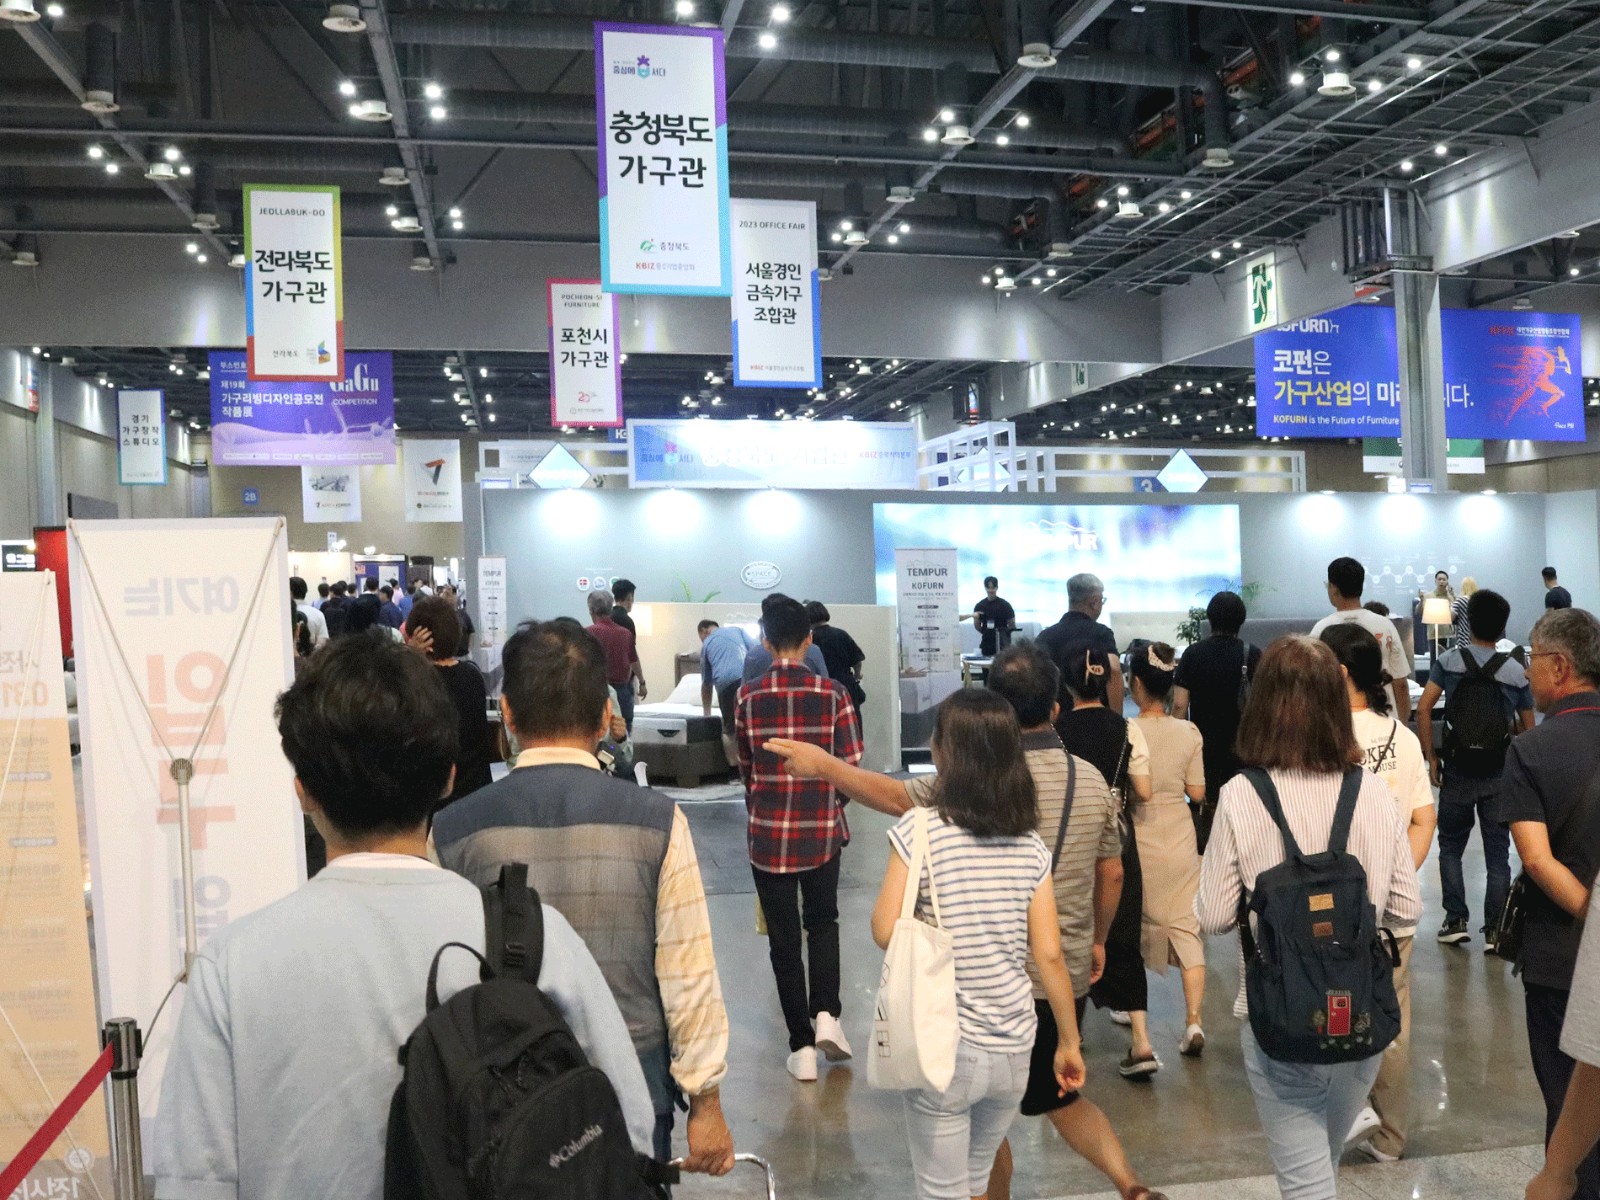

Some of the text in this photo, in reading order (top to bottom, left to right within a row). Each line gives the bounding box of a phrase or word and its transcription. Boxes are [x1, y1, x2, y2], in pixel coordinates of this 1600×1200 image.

[609, 110, 713, 146] 충청북도
[618, 155, 707, 188] 가구관
[259, 207, 326, 216] JEOLLABUK-DO
[739, 220, 805, 230] 2023 OFFICE FAIR
[660, 242, 690, 251] 충청북도
[255, 250, 332, 273] 전라북도
[636, 262, 655, 270] KBIZ
[746, 262, 801, 280] 서울경인
[262, 281, 327, 304] 가구관
[746, 284, 802, 302] 금속가구
[754, 307, 797, 324] 조합관
[1277, 319, 1329, 333] FURN
[561, 327, 607, 345] 포천시
[561, 351, 609, 368] 가구관
[1273, 349, 1332, 375] 코펀은
[221, 392, 324, 406] 가구리빙디자인공모전
[1274, 379, 1371, 406] 가구산업의
[332, 397, 378, 406] COMPETITION
[132, 414, 149, 424] 경기
[221, 406, 253, 418] 작품展
[1273, 415, 1307, 424] KOFURN
[1309, 415, 1315, 424] is
[1318, 415, 1329, 424] the
[1331, 416, 1355, 424] Future
[1357, 415, 1365, 424] of
[122, 438, 159, 446] 스튜디오
[244, 491, 257, 501] 2B
[907, 567, 948, 577] TEMPUR
[559, 1124, 603, 1161] Columbia
